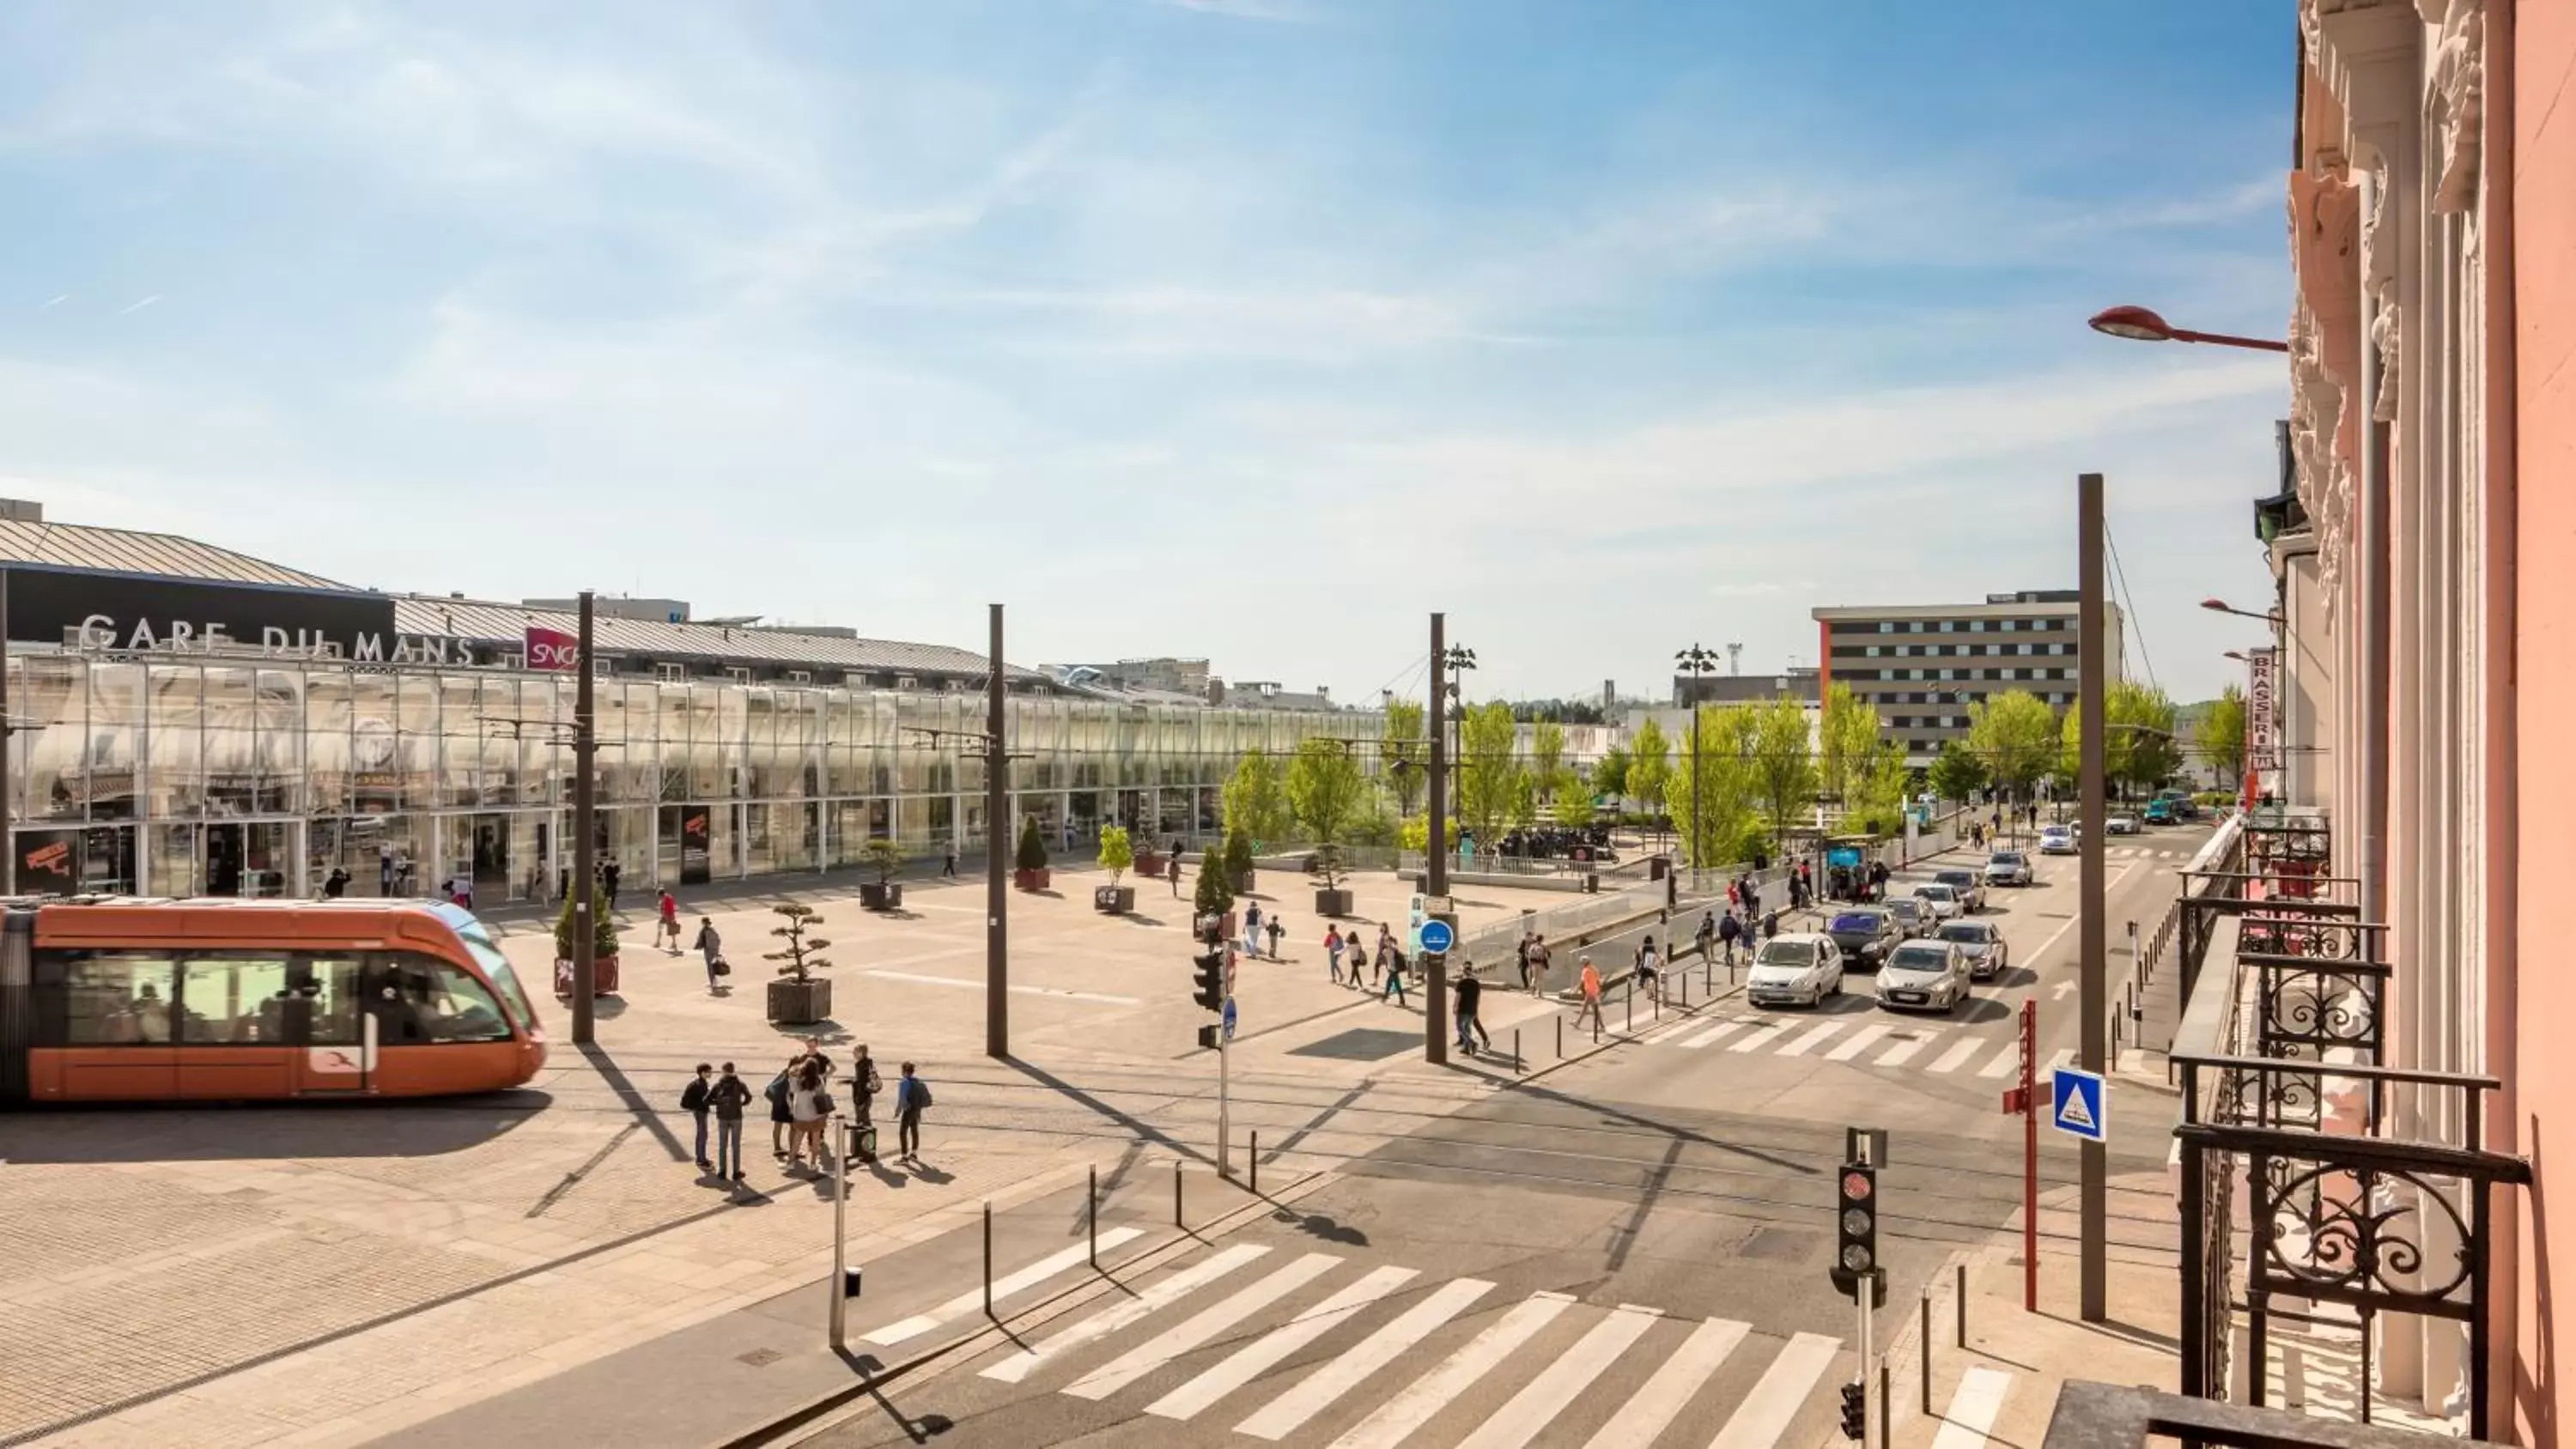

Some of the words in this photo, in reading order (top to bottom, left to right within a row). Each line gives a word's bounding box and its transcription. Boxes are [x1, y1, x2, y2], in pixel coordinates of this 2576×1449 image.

[78, 614, 227, 654] GARE
[262, 624, 325, 657] DU
[353, 631, 474, 664] MANS
[2254, 657, 2272, 755] BRASSERIE
